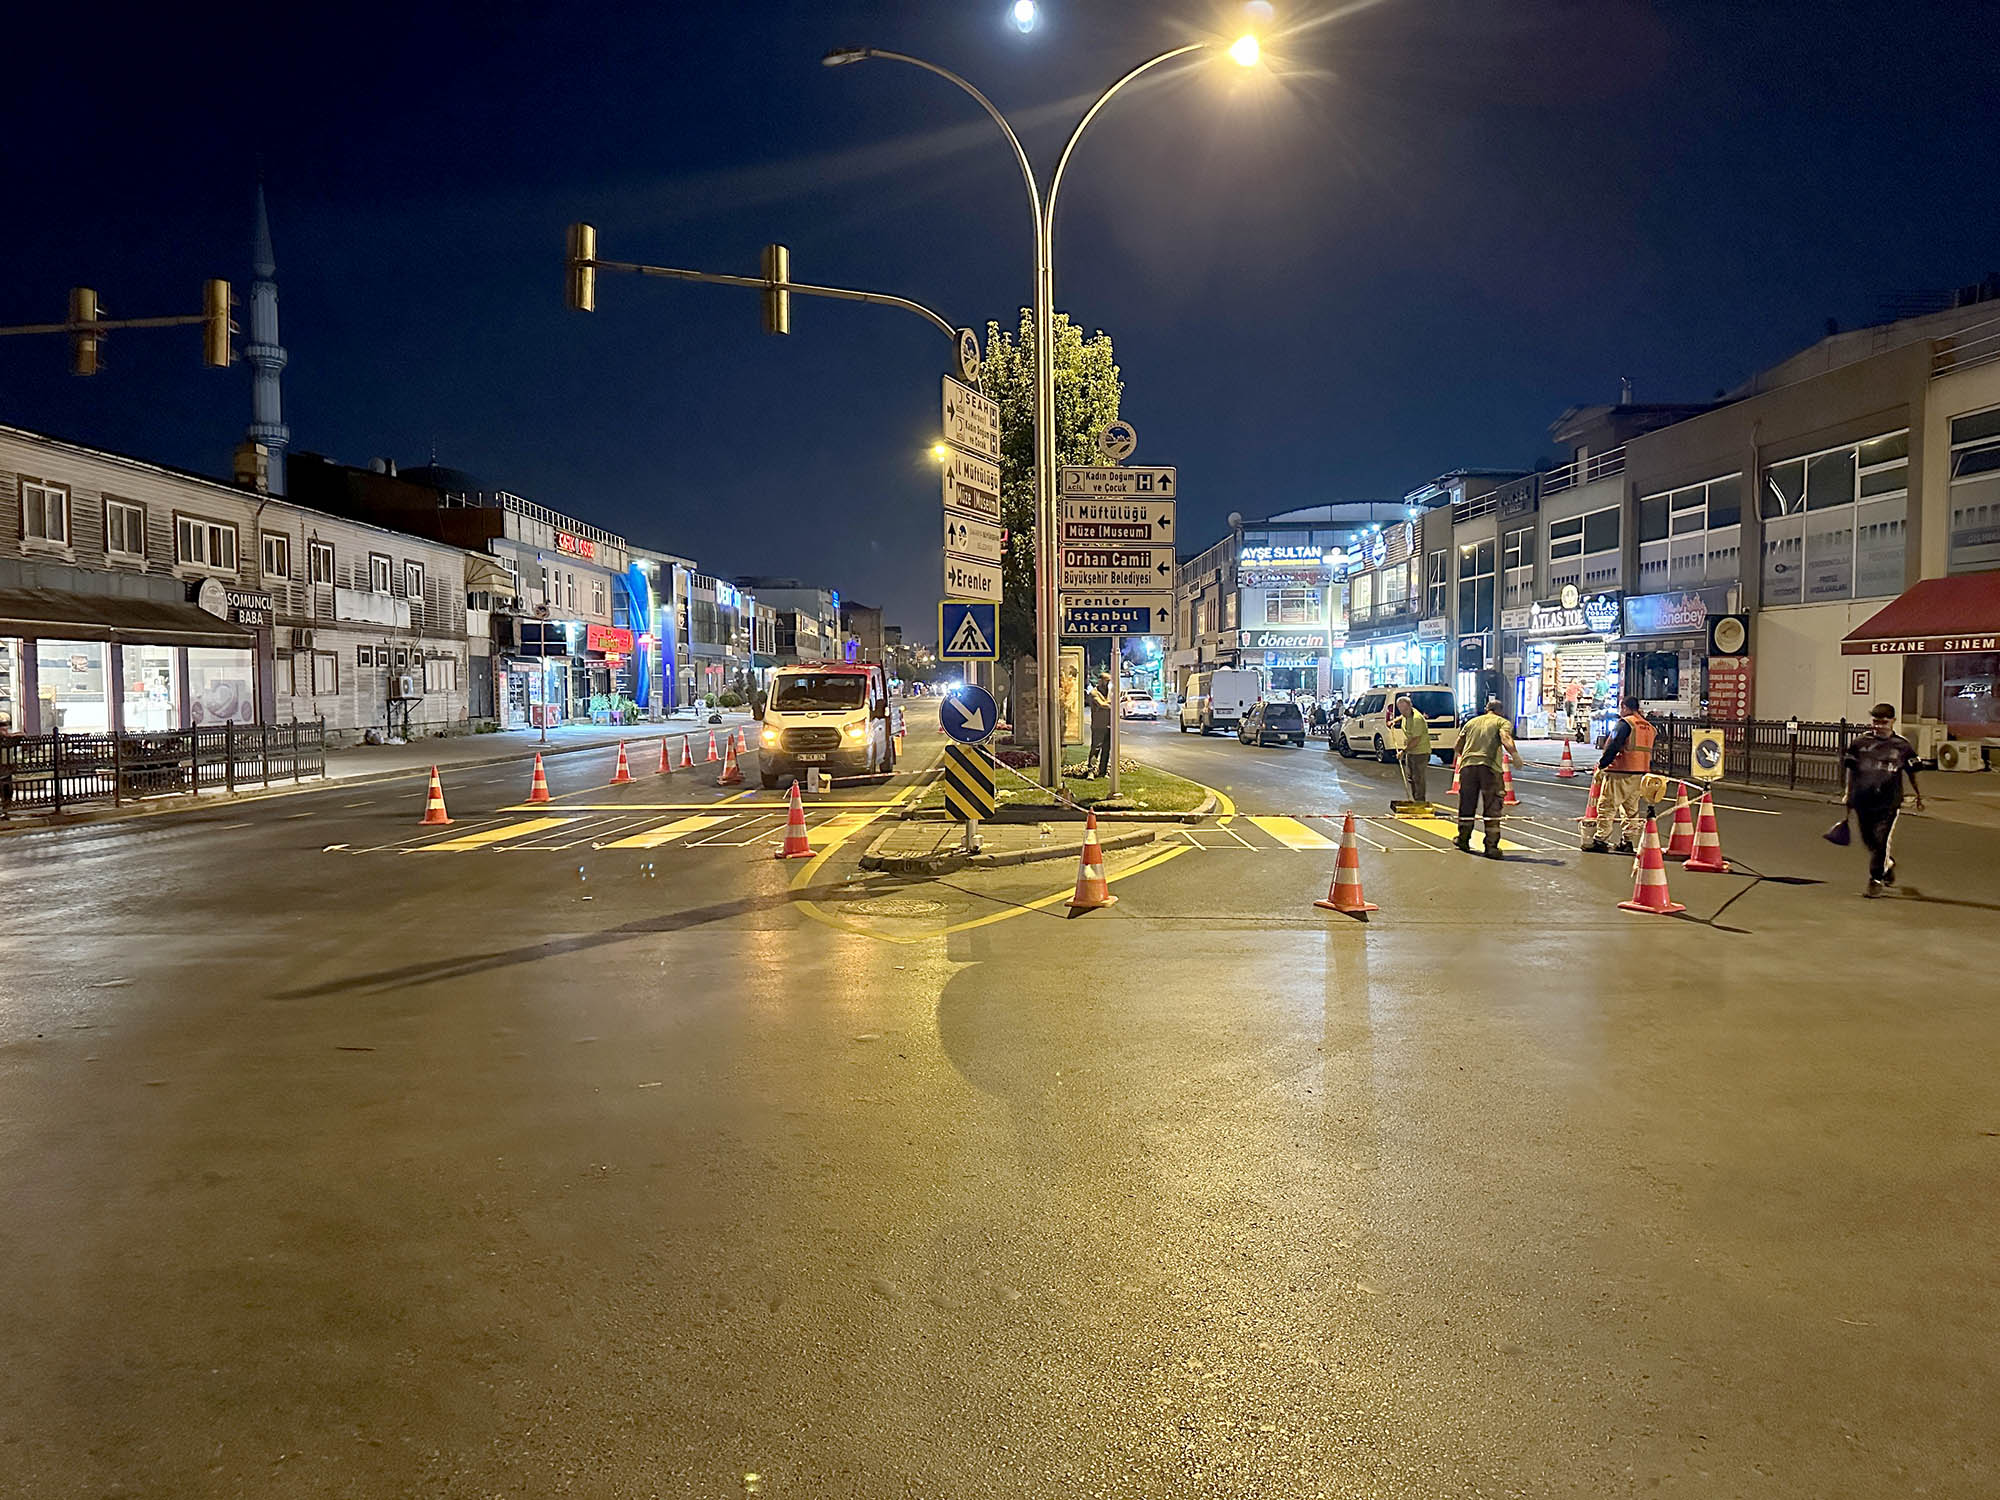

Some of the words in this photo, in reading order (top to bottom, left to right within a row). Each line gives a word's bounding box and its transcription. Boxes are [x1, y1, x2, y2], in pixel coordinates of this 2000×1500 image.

[966, 393, 989, 414] SEAH
[964, 462, 998, 491] Müftülüğü
[1085, 471, 1107, 481] Kadın
[1110, 471, 1135, 483] Doğum
[1093, 484, 1102, 492] ve
[1105, 483, 1127, 494] Çocuk
[1065, 502, 1074, 519] İl
[1080, 505, 1147, 522] Müftülüğü
[1069, 524, 1096, 537] Müze
[1099, 525, 1149, 539] (Museum)
[1067, 551, 1107, 566] Orhan
[1112, 552, 1150, 567] Camii
[1241, 547, 1273, 560] AYŞE
[1273, 546, 1321, 558] SULTAN
[957, 568, 992, 592] Erenler
[1064, 570, 1108, 586] Büyükşehir
[1111, 571, 1152, 587] Belediyesi
[227, 592, 273, 610] SOMUNCU
[1064, 596, 1129, 606] Erenler
[1587, 601, 1619, 612] ATLAS
[239, 610, 264, 625] BABA
[1067, 608, 1139, 621] İstanbul
[1532, 610, 1564, 629] ATLAS
[1067, 622, 1128, 632] Ankara
[1257, 631, 1324, 647] dönercim
[1871, 641, 1926, 653] ECZANE
[1856, 673, 1866, 690] E
